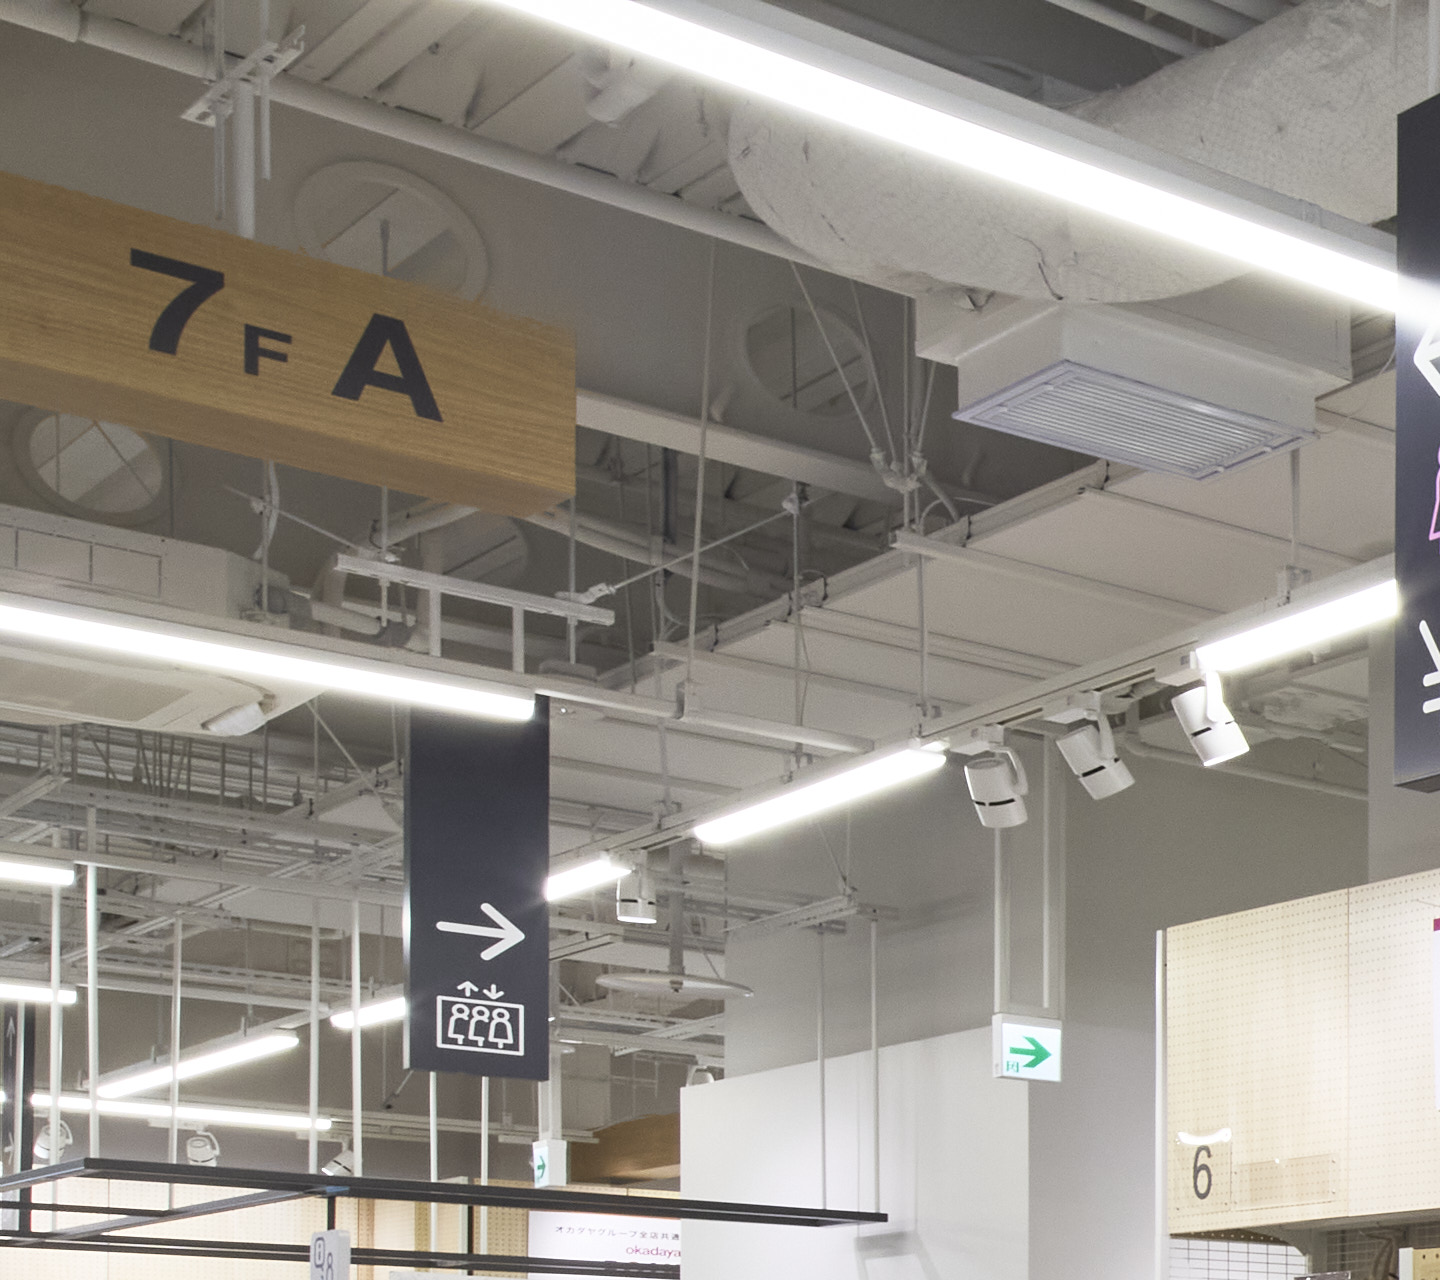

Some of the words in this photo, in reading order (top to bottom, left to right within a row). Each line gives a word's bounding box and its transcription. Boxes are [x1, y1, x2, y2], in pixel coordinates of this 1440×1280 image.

[330, 313, 444, 423] A
[1191, 1145, 1214, 1200] 6
[625, 1244, 682, 1260] okadaya
